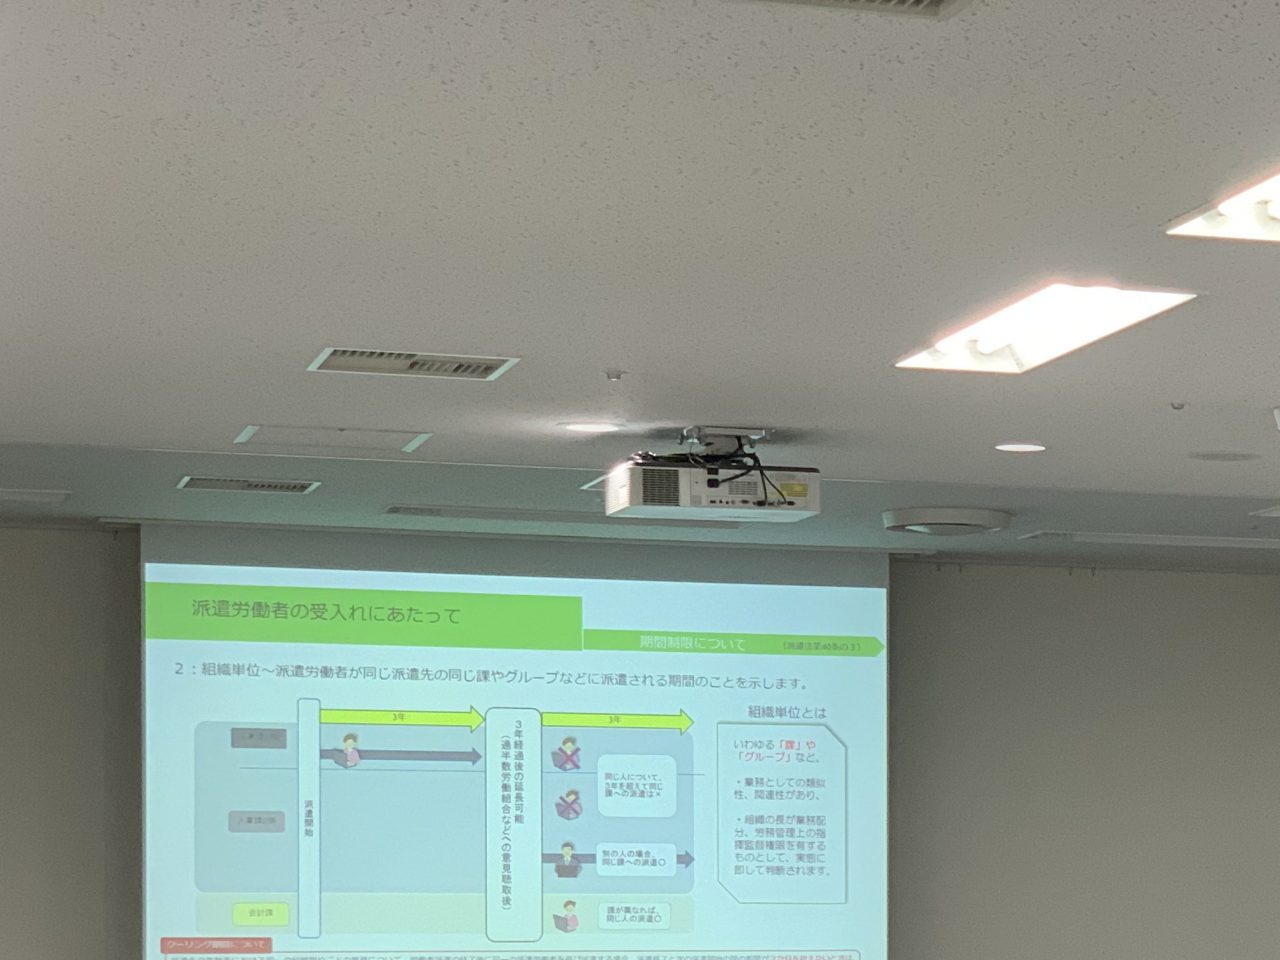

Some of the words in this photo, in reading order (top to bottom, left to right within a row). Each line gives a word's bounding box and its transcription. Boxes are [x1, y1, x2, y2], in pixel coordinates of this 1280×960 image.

[192, 599, 461, 625] 派遣労働者の受入れにあたって
[640, 635, 747, 652] 期間制限について
[748, 704, 828, 721] 組織単位とは
